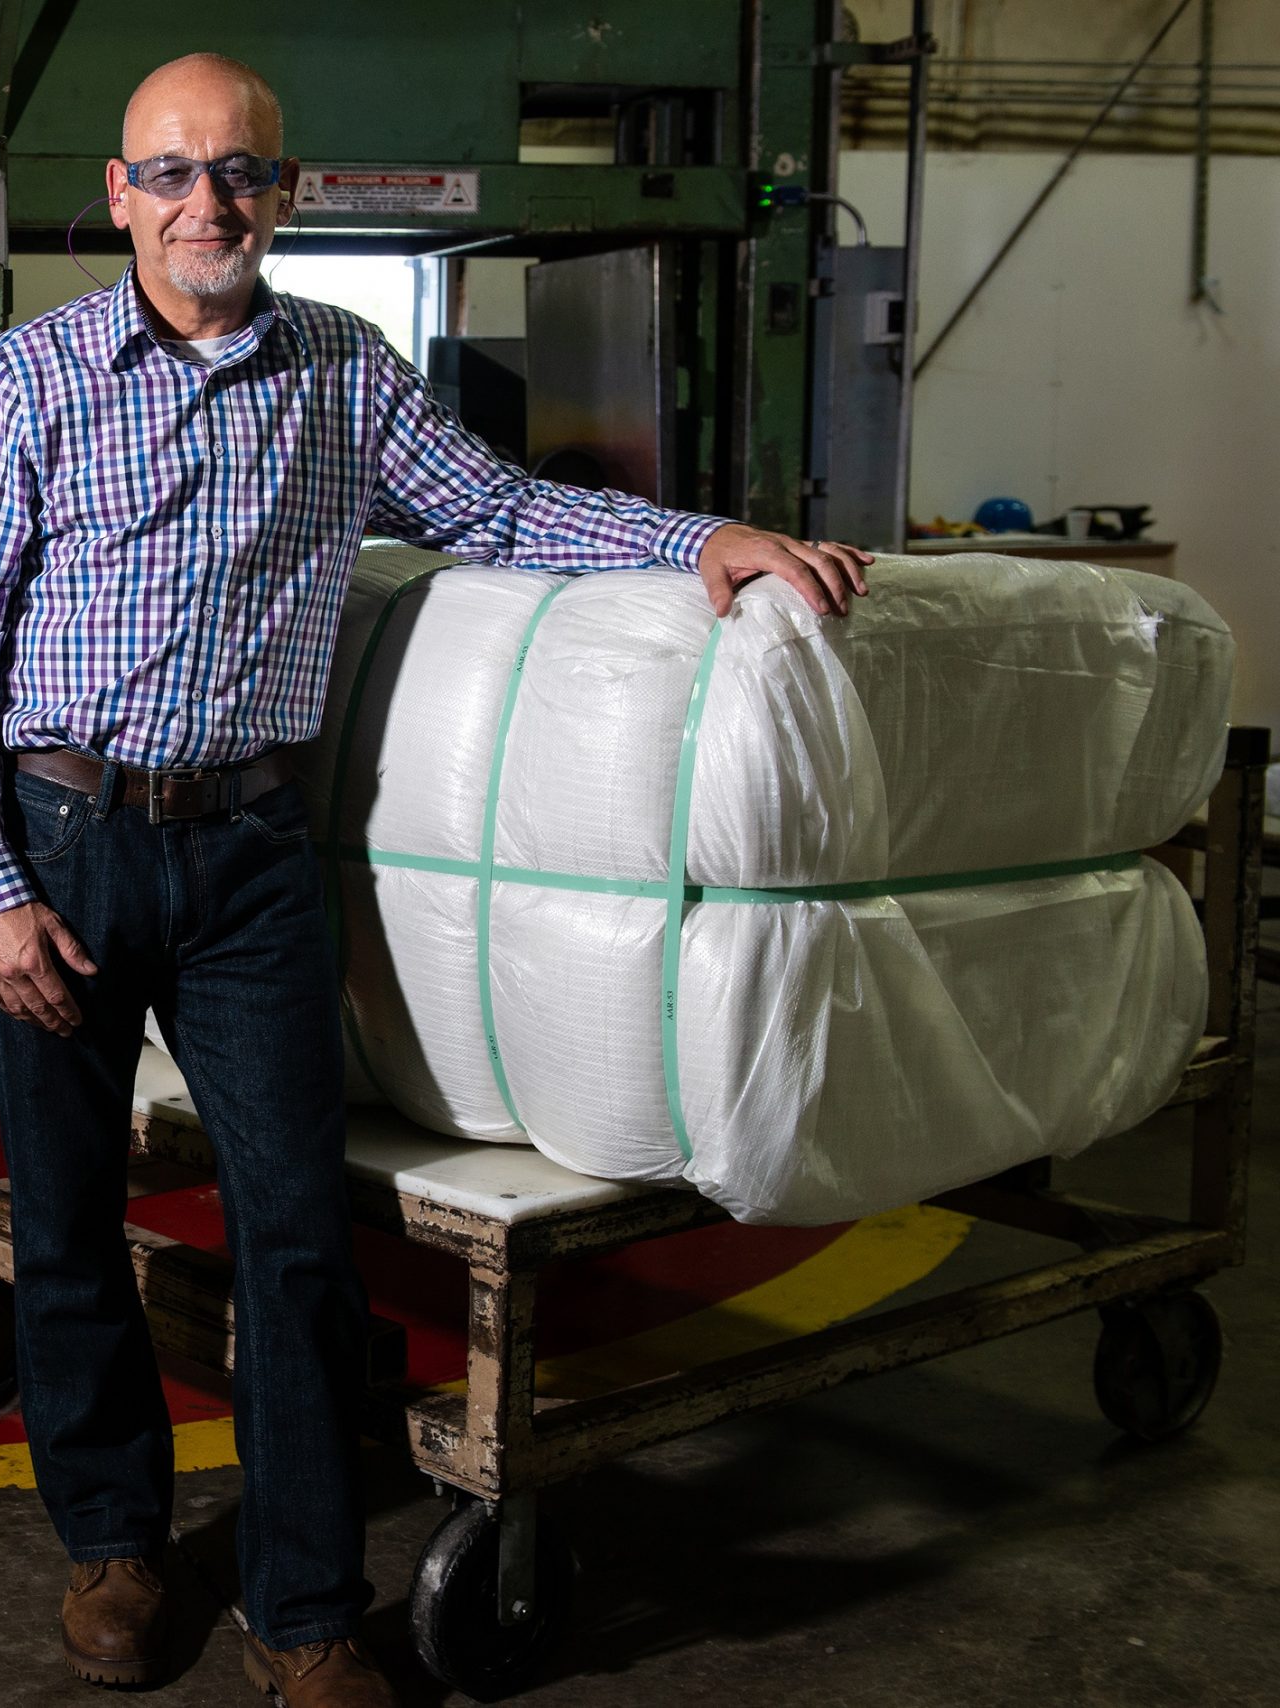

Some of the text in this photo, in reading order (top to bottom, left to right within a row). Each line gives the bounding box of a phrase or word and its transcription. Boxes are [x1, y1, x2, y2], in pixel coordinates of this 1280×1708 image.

[336, 176, 431, 185] DANGER PELIGRO
[666, 990, 674, 1021] AAR-53
